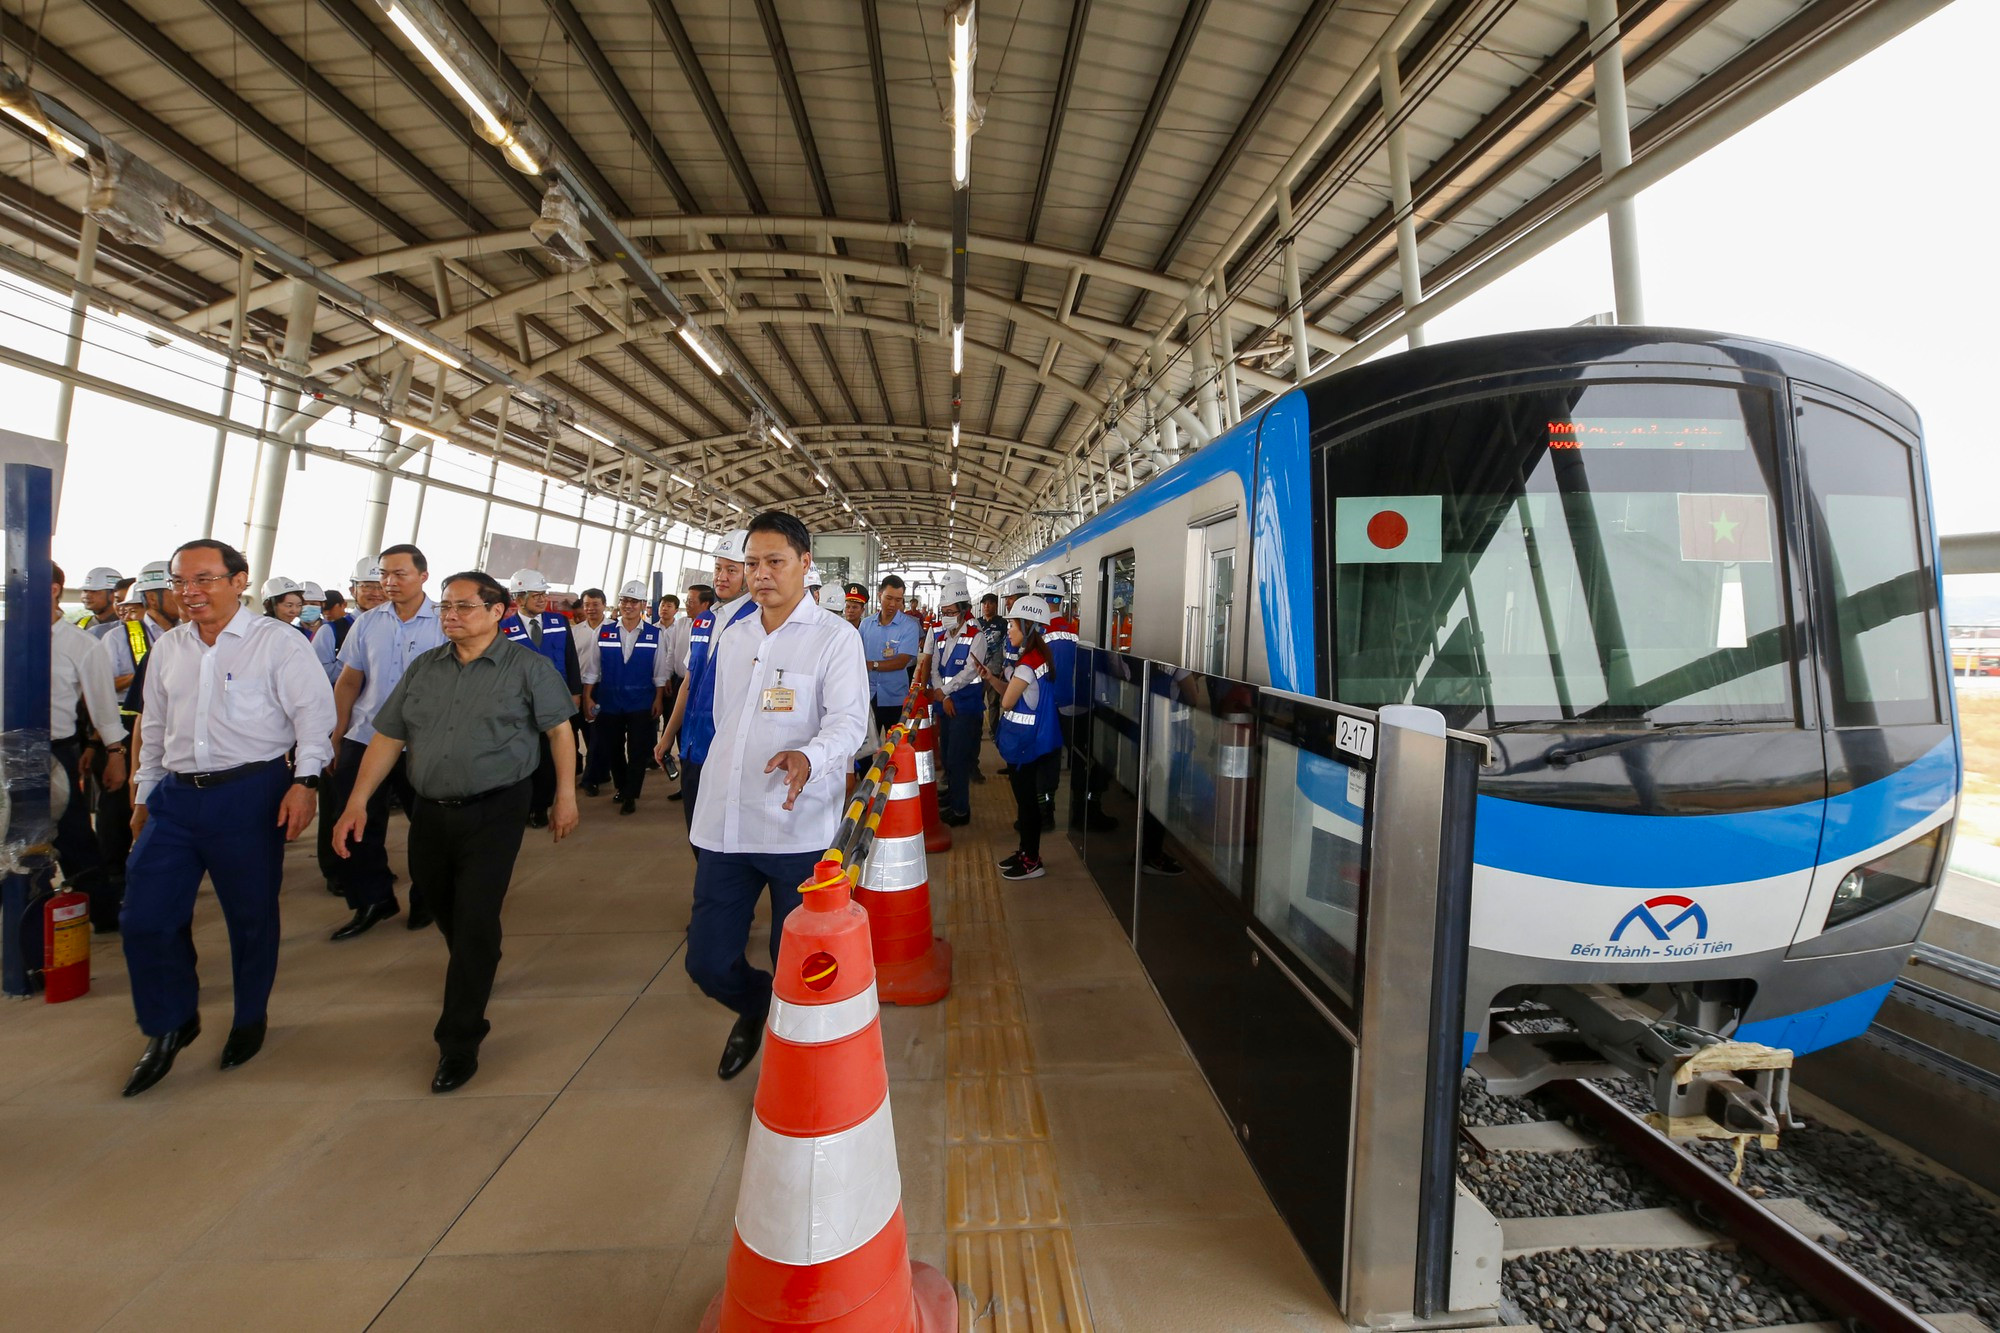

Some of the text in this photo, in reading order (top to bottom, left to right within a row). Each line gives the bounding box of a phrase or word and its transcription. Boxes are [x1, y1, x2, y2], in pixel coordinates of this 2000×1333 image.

[1020, 605, 1043, 615] MAUR
[1340, 721, 1367, 751] 2-17
[1570, 943, 1601, 957] Bến
[1604, 945, 1650, 958] Thành
[1664, 942, 1699, 957] Suối
[1702, 941, 1733, 954] Tiên
